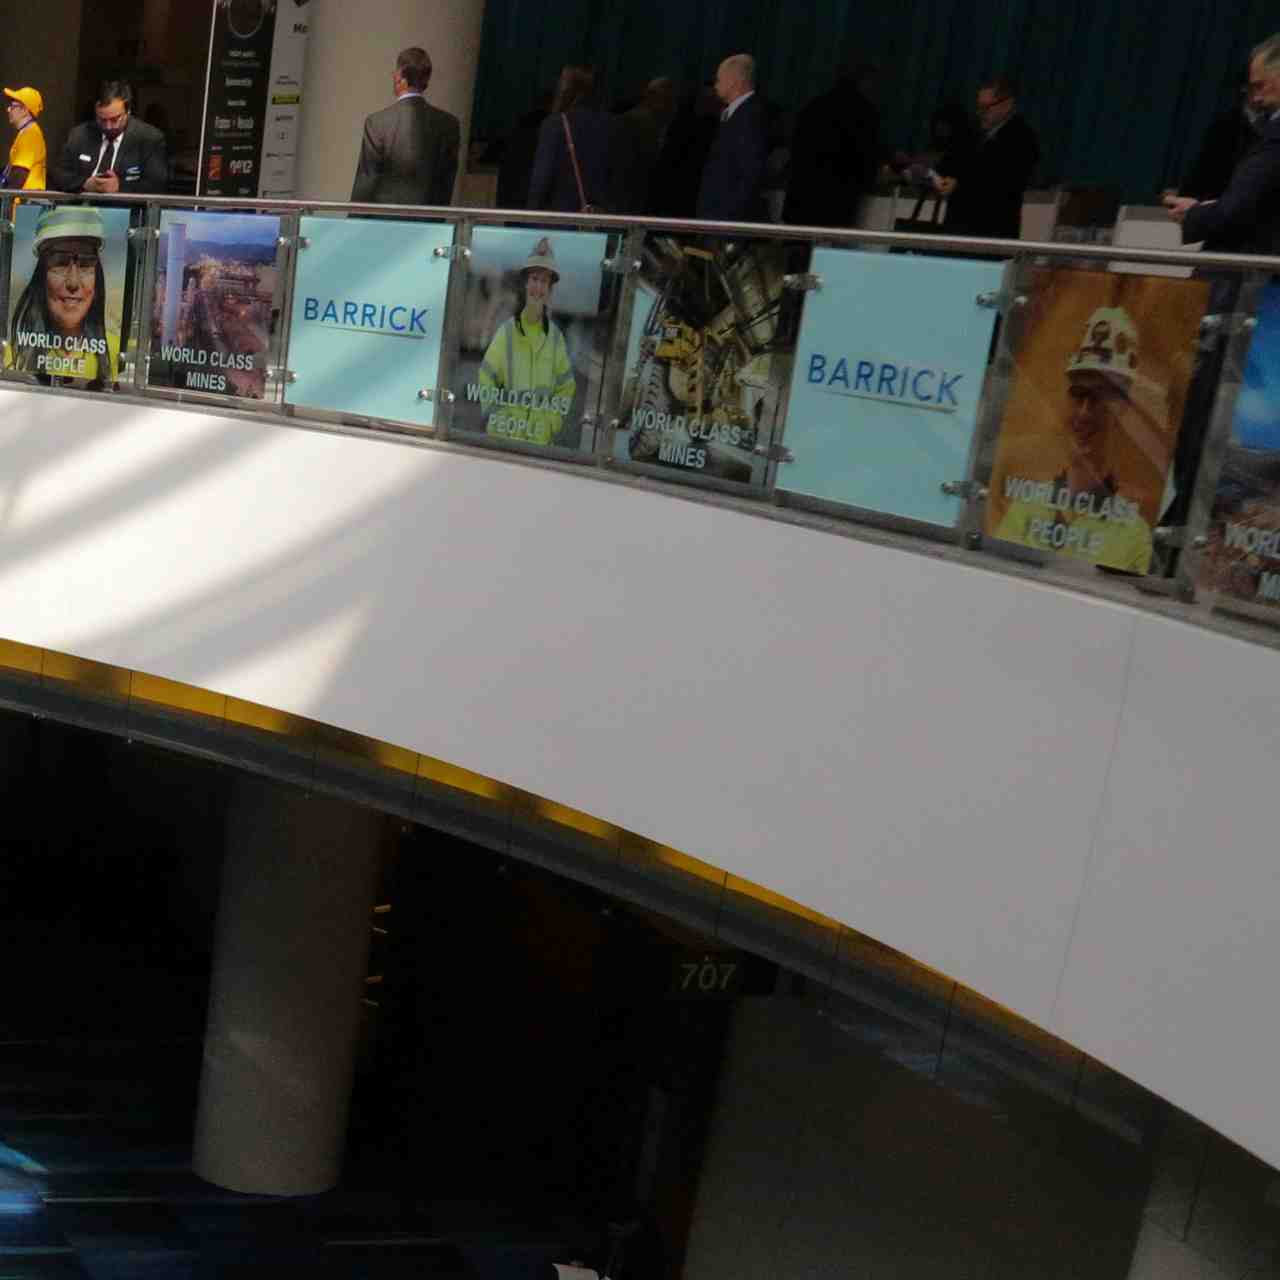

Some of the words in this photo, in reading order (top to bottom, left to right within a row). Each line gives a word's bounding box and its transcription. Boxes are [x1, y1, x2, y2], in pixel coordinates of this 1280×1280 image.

[304, 298, 427, 334] BARRICK
[17, 331, 62, 350] WORLD
[64, 335, 107, 355] CLASS
[37, 355, 86, 375] PEOPLE
[161, 345, 207, 366] WORLD
[210, 351, 255, 371] CLASS
[186, 370, 226, 392] MINES
[808, 353, 964, 407] BARRICK
[466, 383, 517, 407] WORLD
[519, 389, 570, 416] CLASS
[489, 412, 544, 436] PEOPLE
[632, 407, 687, 434] WORLD
[689, 419, 742, 446] CLASS
[658, 446, 706, 469] MINES
[1006, 474, 1071, 512] WORLD
[1074, 490, 1139, 526] CLASS
[679, 962, 737, 992] 707
